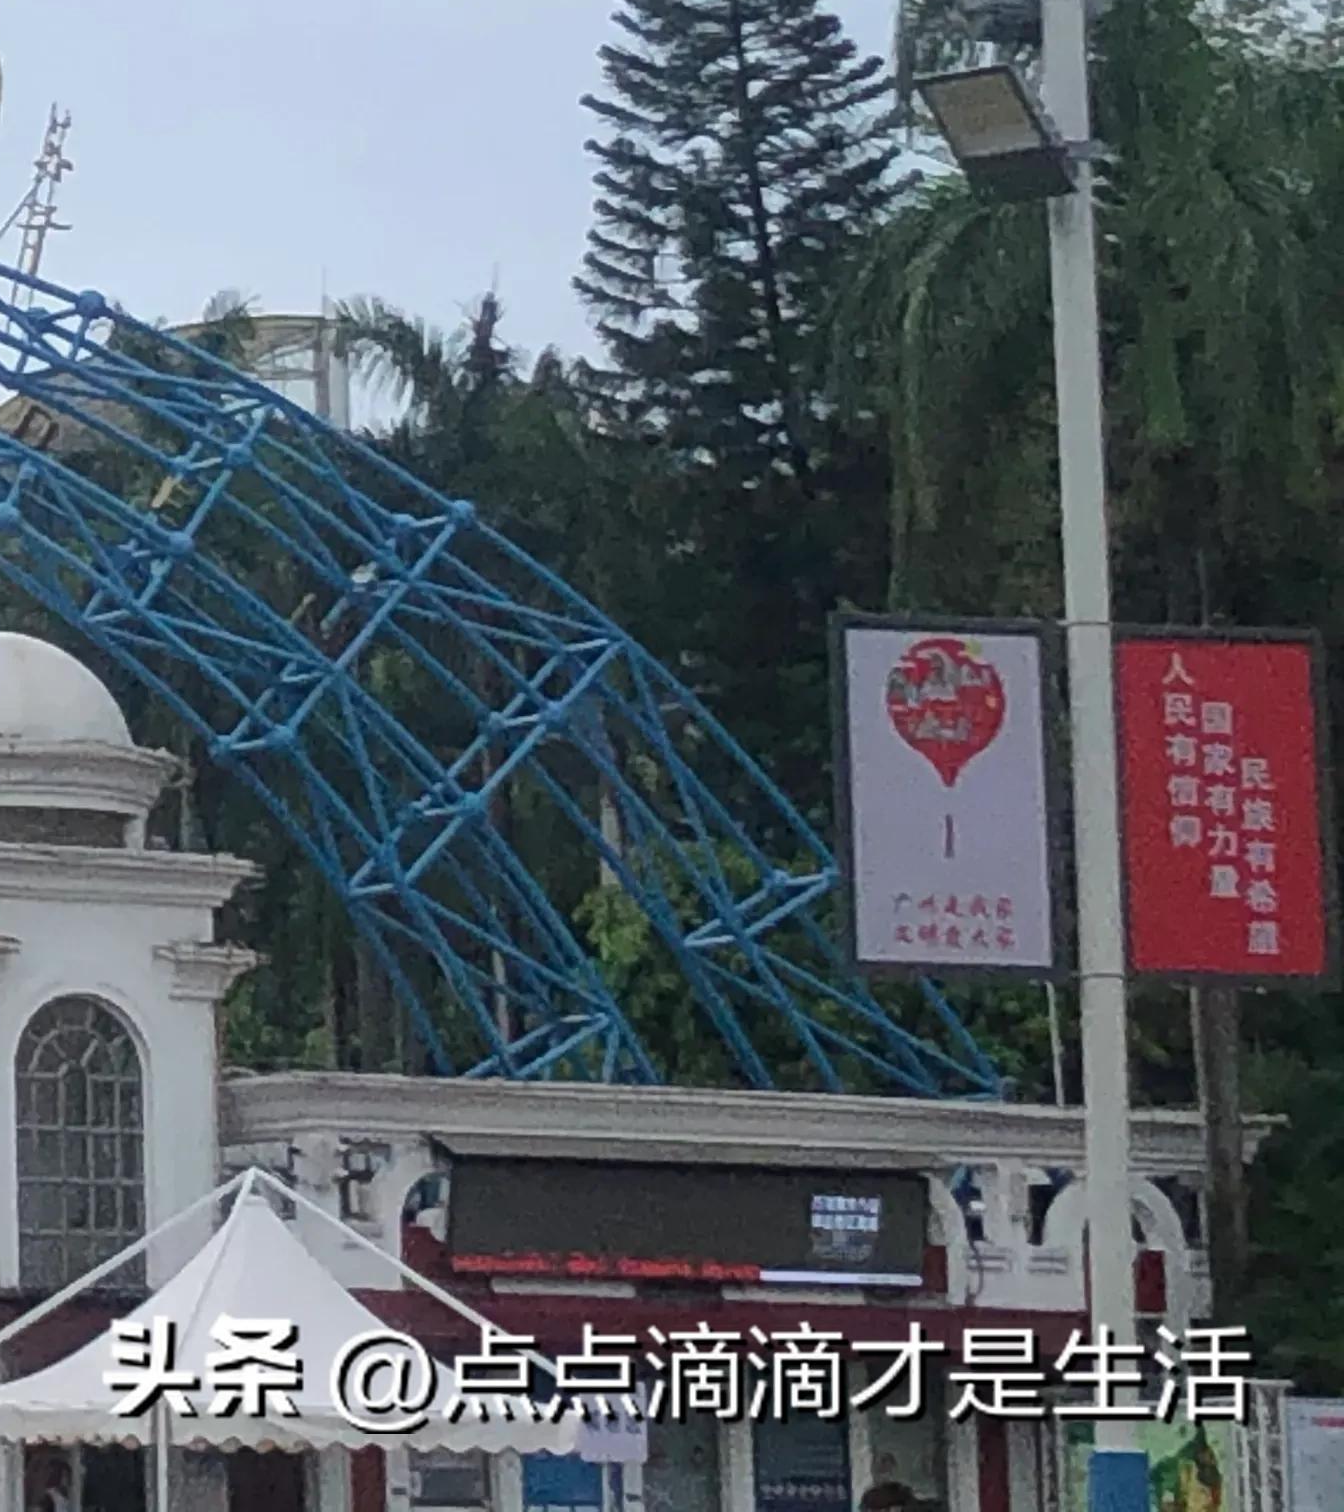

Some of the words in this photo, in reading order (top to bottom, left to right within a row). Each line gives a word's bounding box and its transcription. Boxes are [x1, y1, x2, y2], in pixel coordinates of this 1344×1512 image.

[1162, 651, 1202, 848] 人民有信仰
[1200, 701, 1241, 899] 国家有力量
[1240, 757, 1281, 955] 民族有希望
